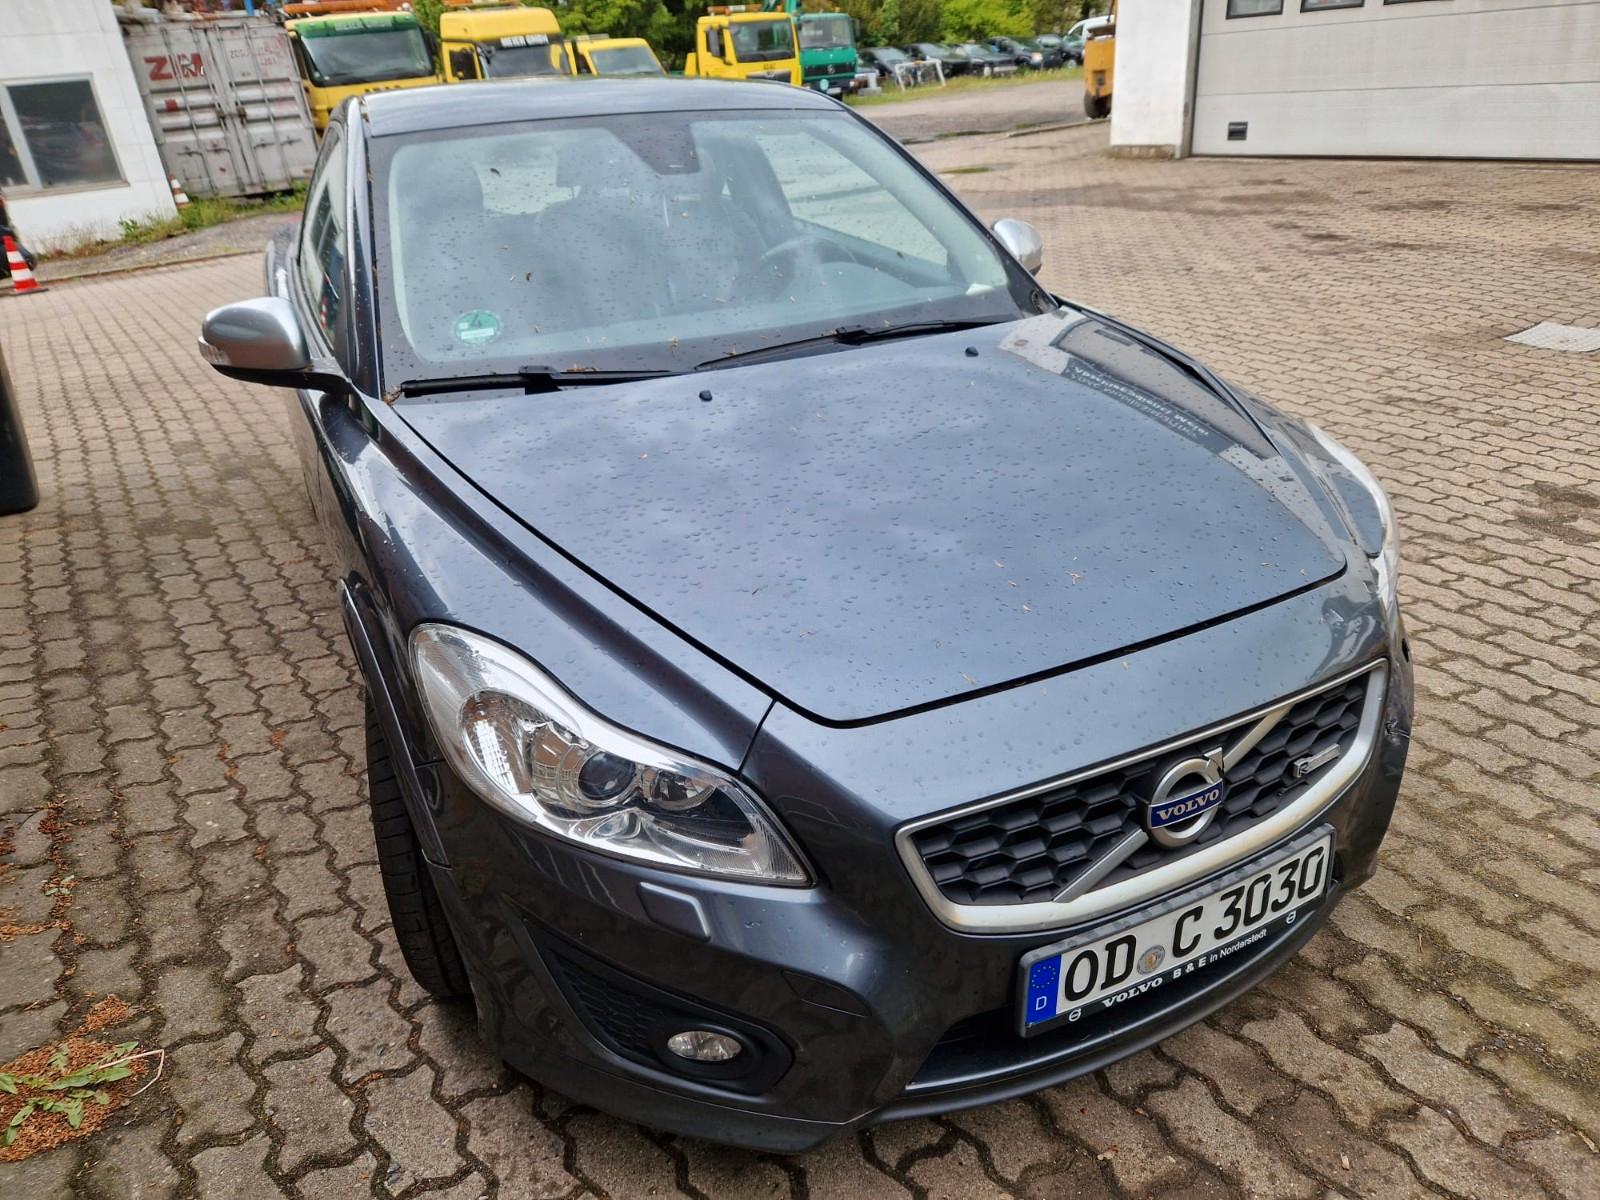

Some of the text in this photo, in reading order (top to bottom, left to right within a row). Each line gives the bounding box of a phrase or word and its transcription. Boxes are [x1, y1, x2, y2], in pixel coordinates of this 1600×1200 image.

[1157, 788, 1220, 821] VOLVO
[1064, 846, 1324, 1002] OD C 3030
[1102, 929, 1267, 1008] VOLVO B & E in Norderstedt
[1035, 995, 1047, 1011] D
